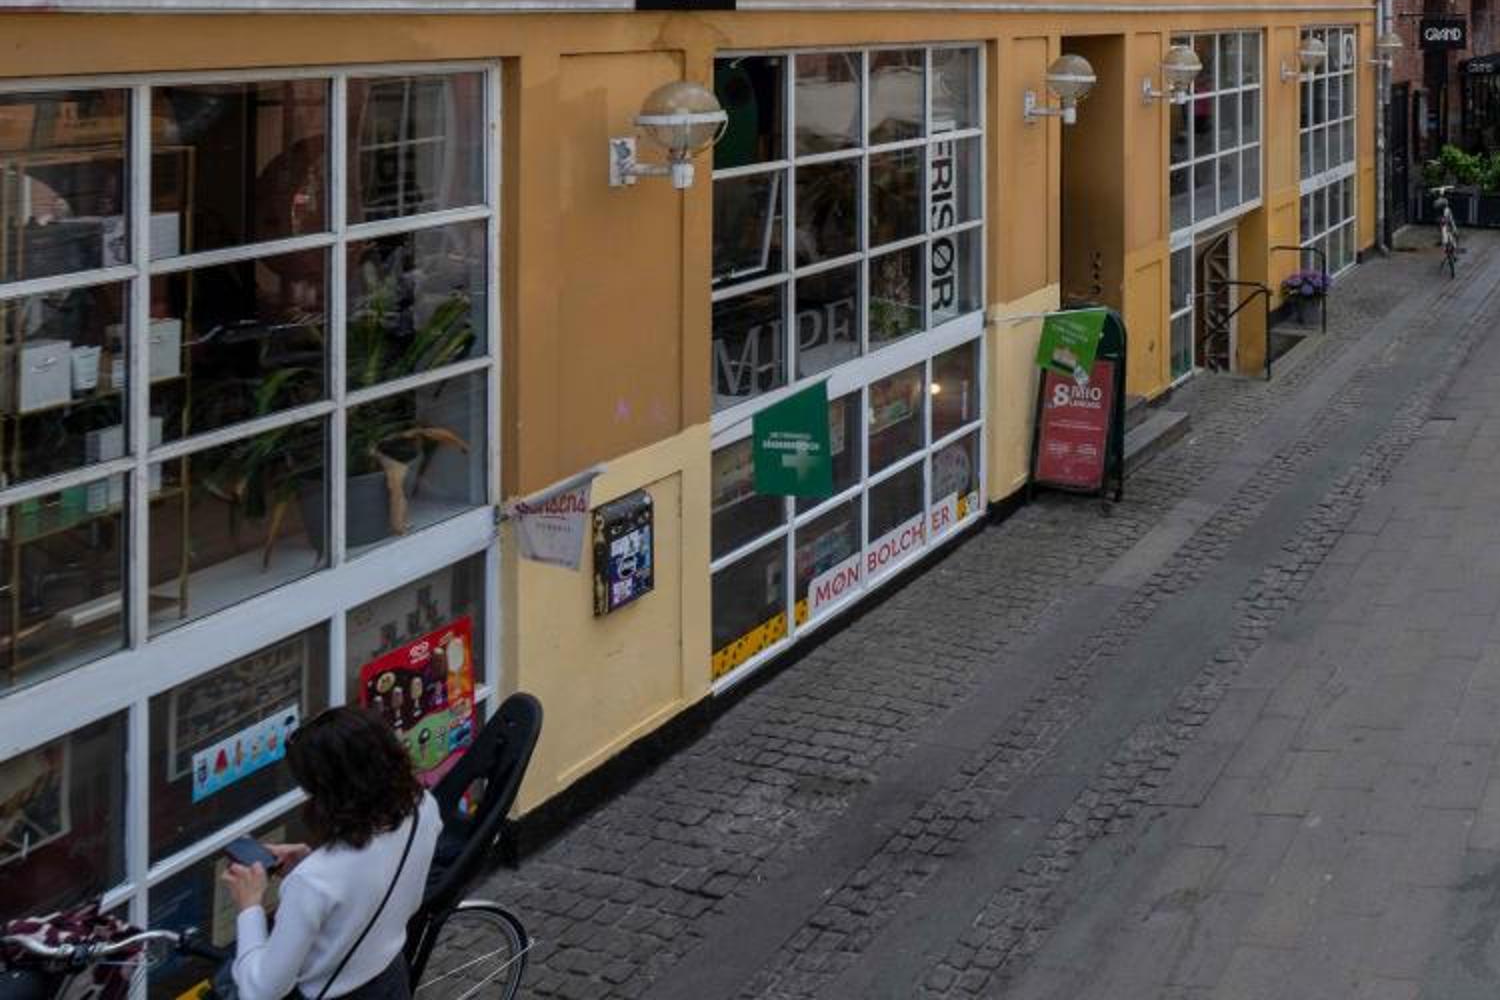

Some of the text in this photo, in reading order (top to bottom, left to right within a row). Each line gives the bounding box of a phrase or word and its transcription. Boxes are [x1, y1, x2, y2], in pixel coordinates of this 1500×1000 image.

[1424, 27, 1462, 41] GRAND
[931, 129, 955, 312] FRISØR
[814, 562, 861, 607] MØN
